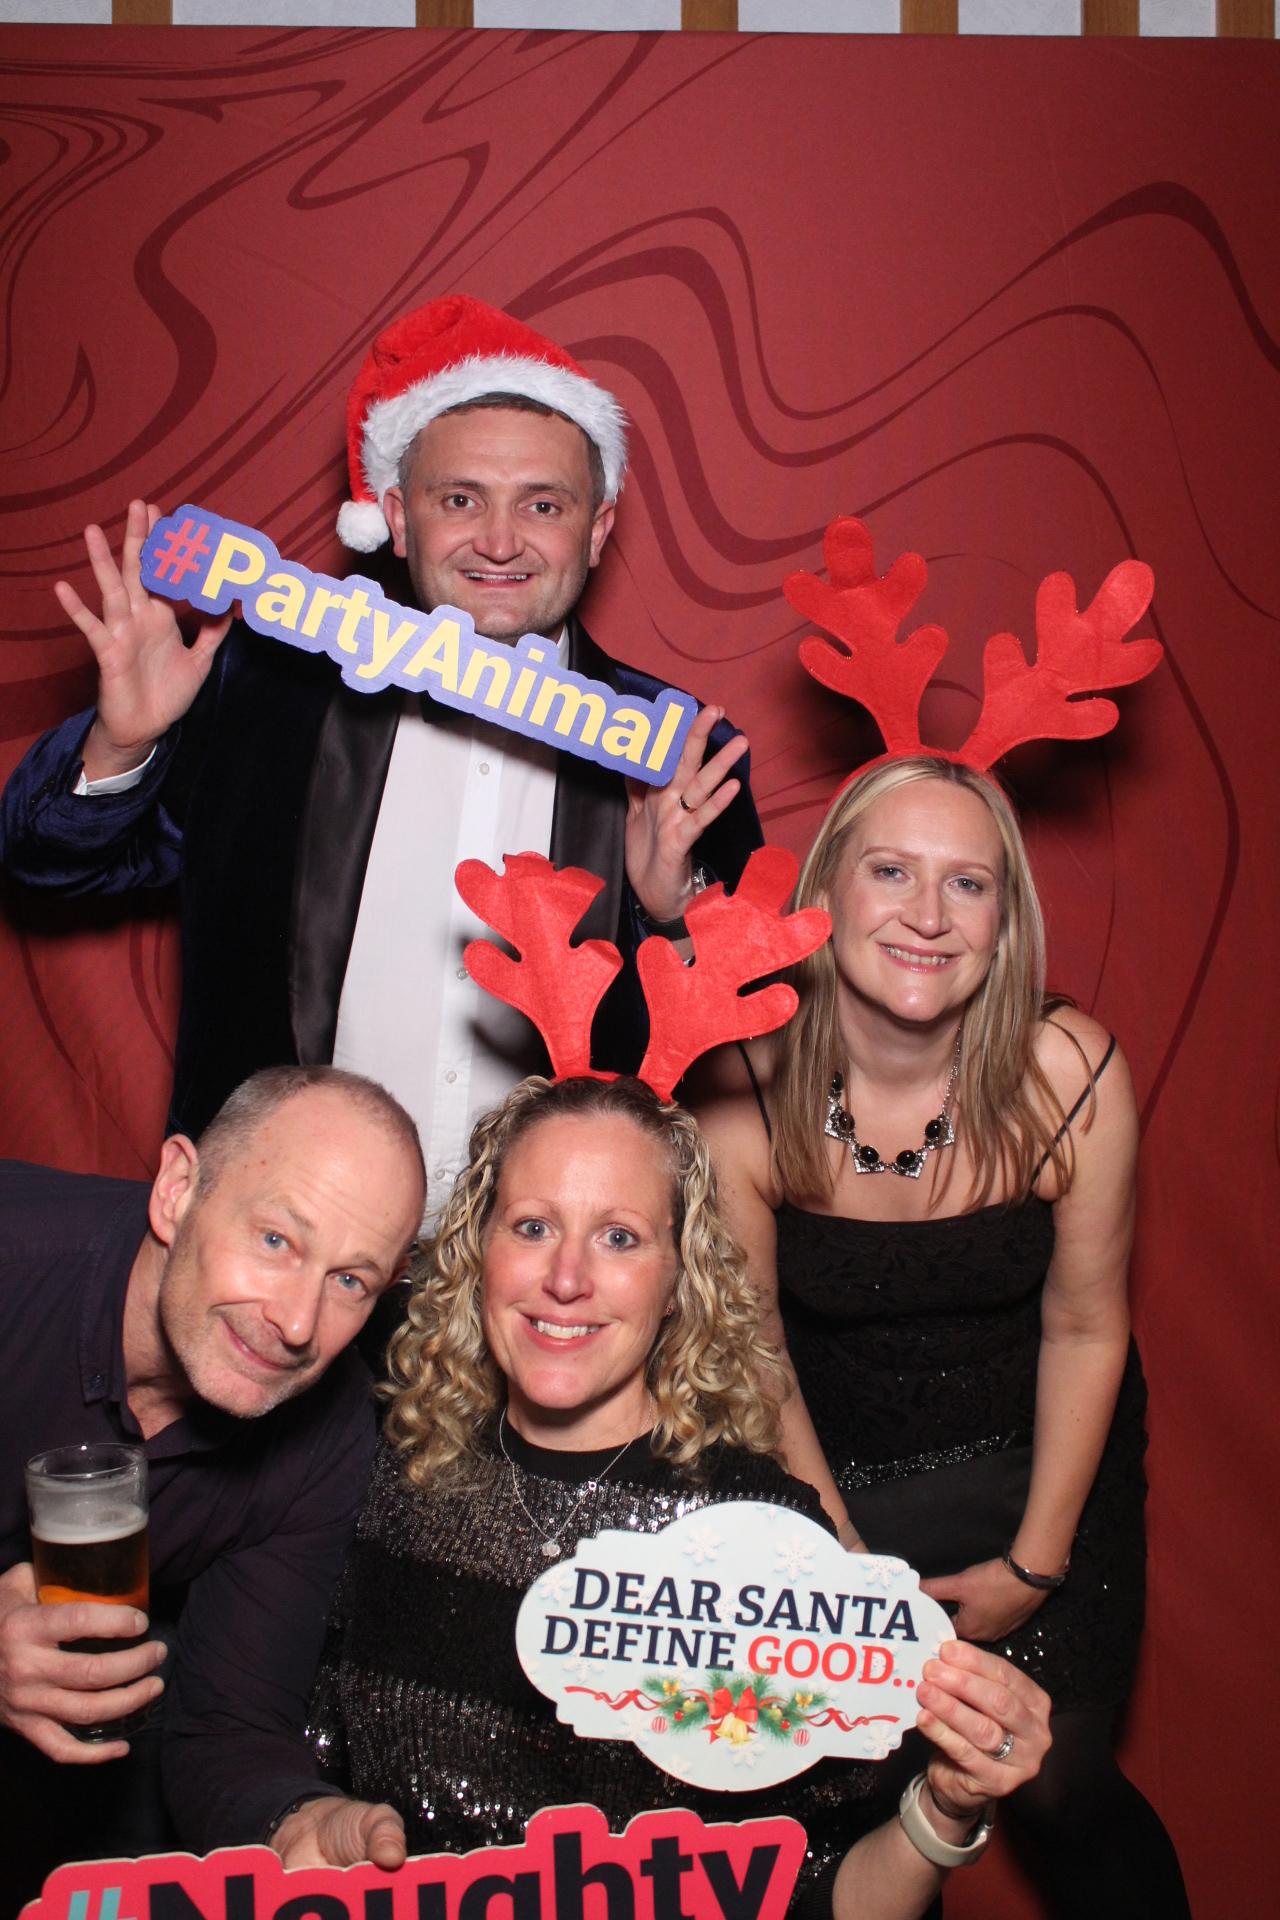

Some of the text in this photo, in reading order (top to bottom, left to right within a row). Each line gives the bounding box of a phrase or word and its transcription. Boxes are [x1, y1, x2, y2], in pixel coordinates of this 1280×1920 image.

[153, 517, 685, 773] #PartyAnimal
[570, 1567, 919, 1642] DEAR SANTA
[540, 1615, 736, 1672] DEFINE
